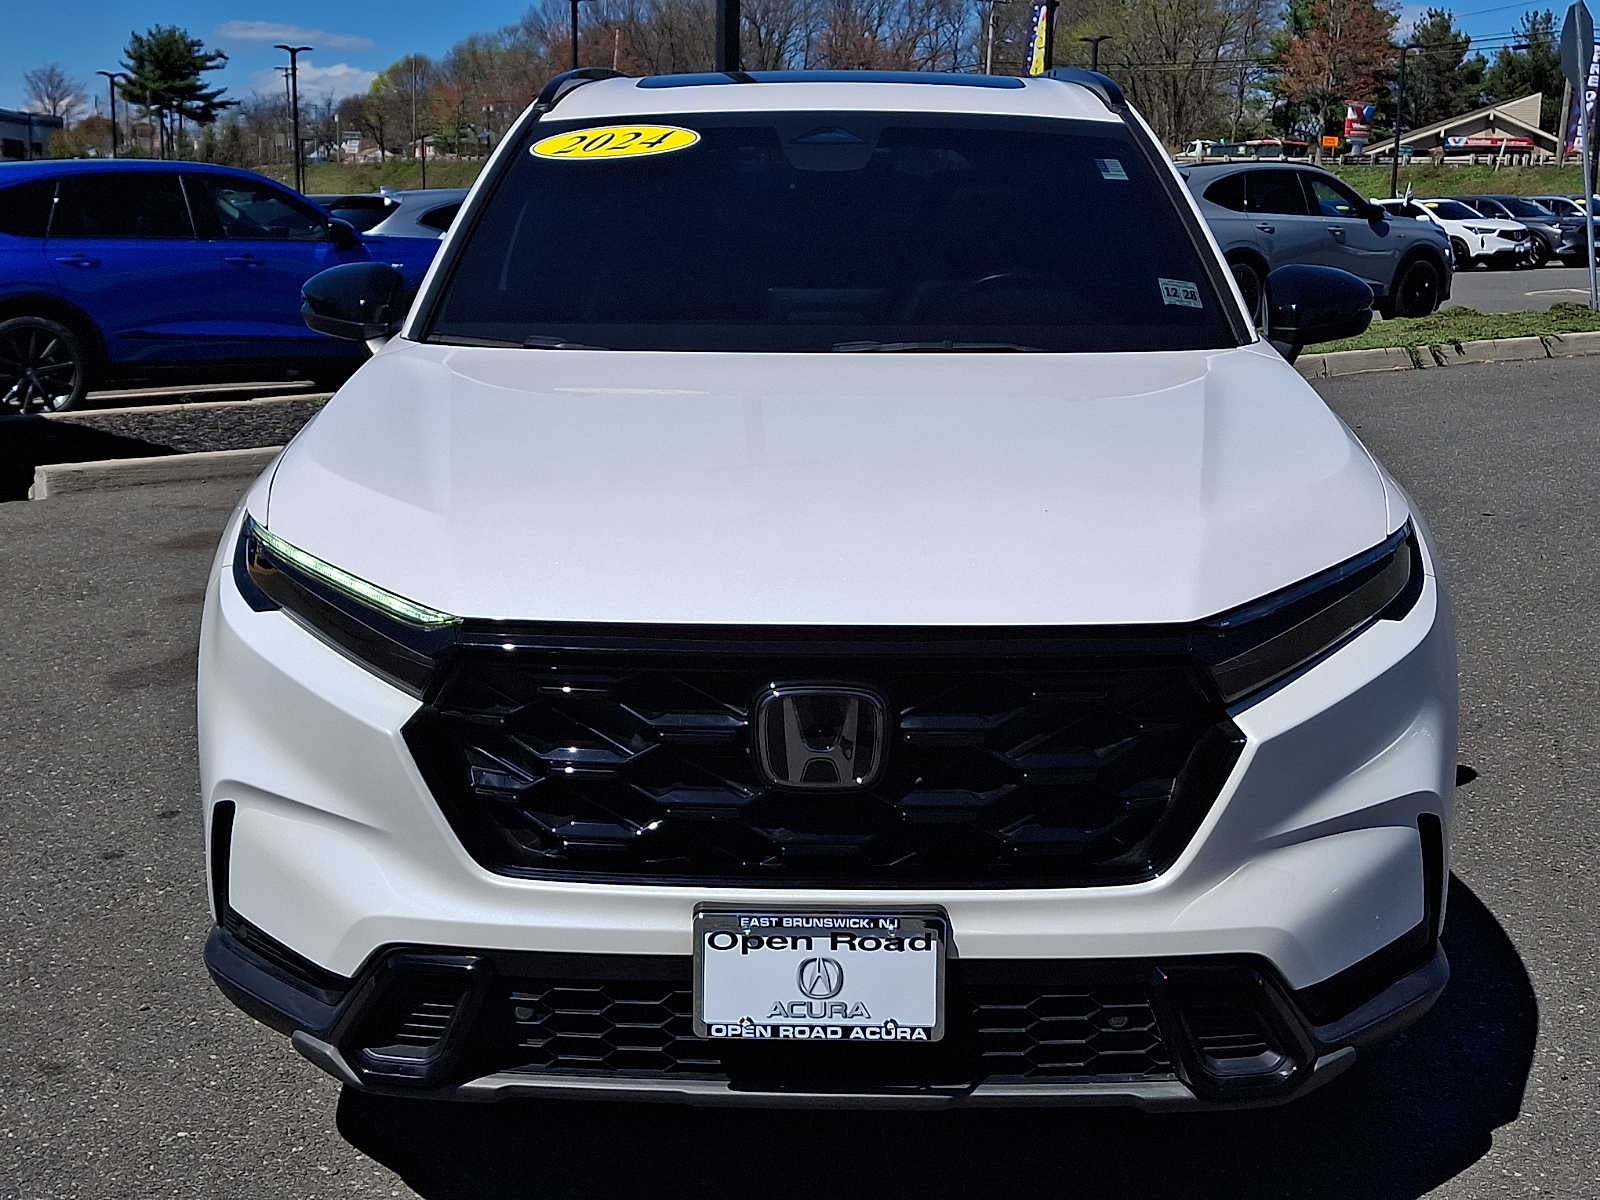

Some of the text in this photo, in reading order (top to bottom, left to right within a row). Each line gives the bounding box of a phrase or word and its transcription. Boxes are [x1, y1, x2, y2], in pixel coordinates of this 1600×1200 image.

[553, 130, 677, 154] 2024
[1164, 286, 1180, 298] 12
[740, 917, 778, 928] EAST
[879, 918, 898, 930] NJ
[707, 930, 932, 955] Open Road
[767, 1000, 871, 1019] ACURA
[711, 1023, 928, 1040] OPEN ROAD ACURA
